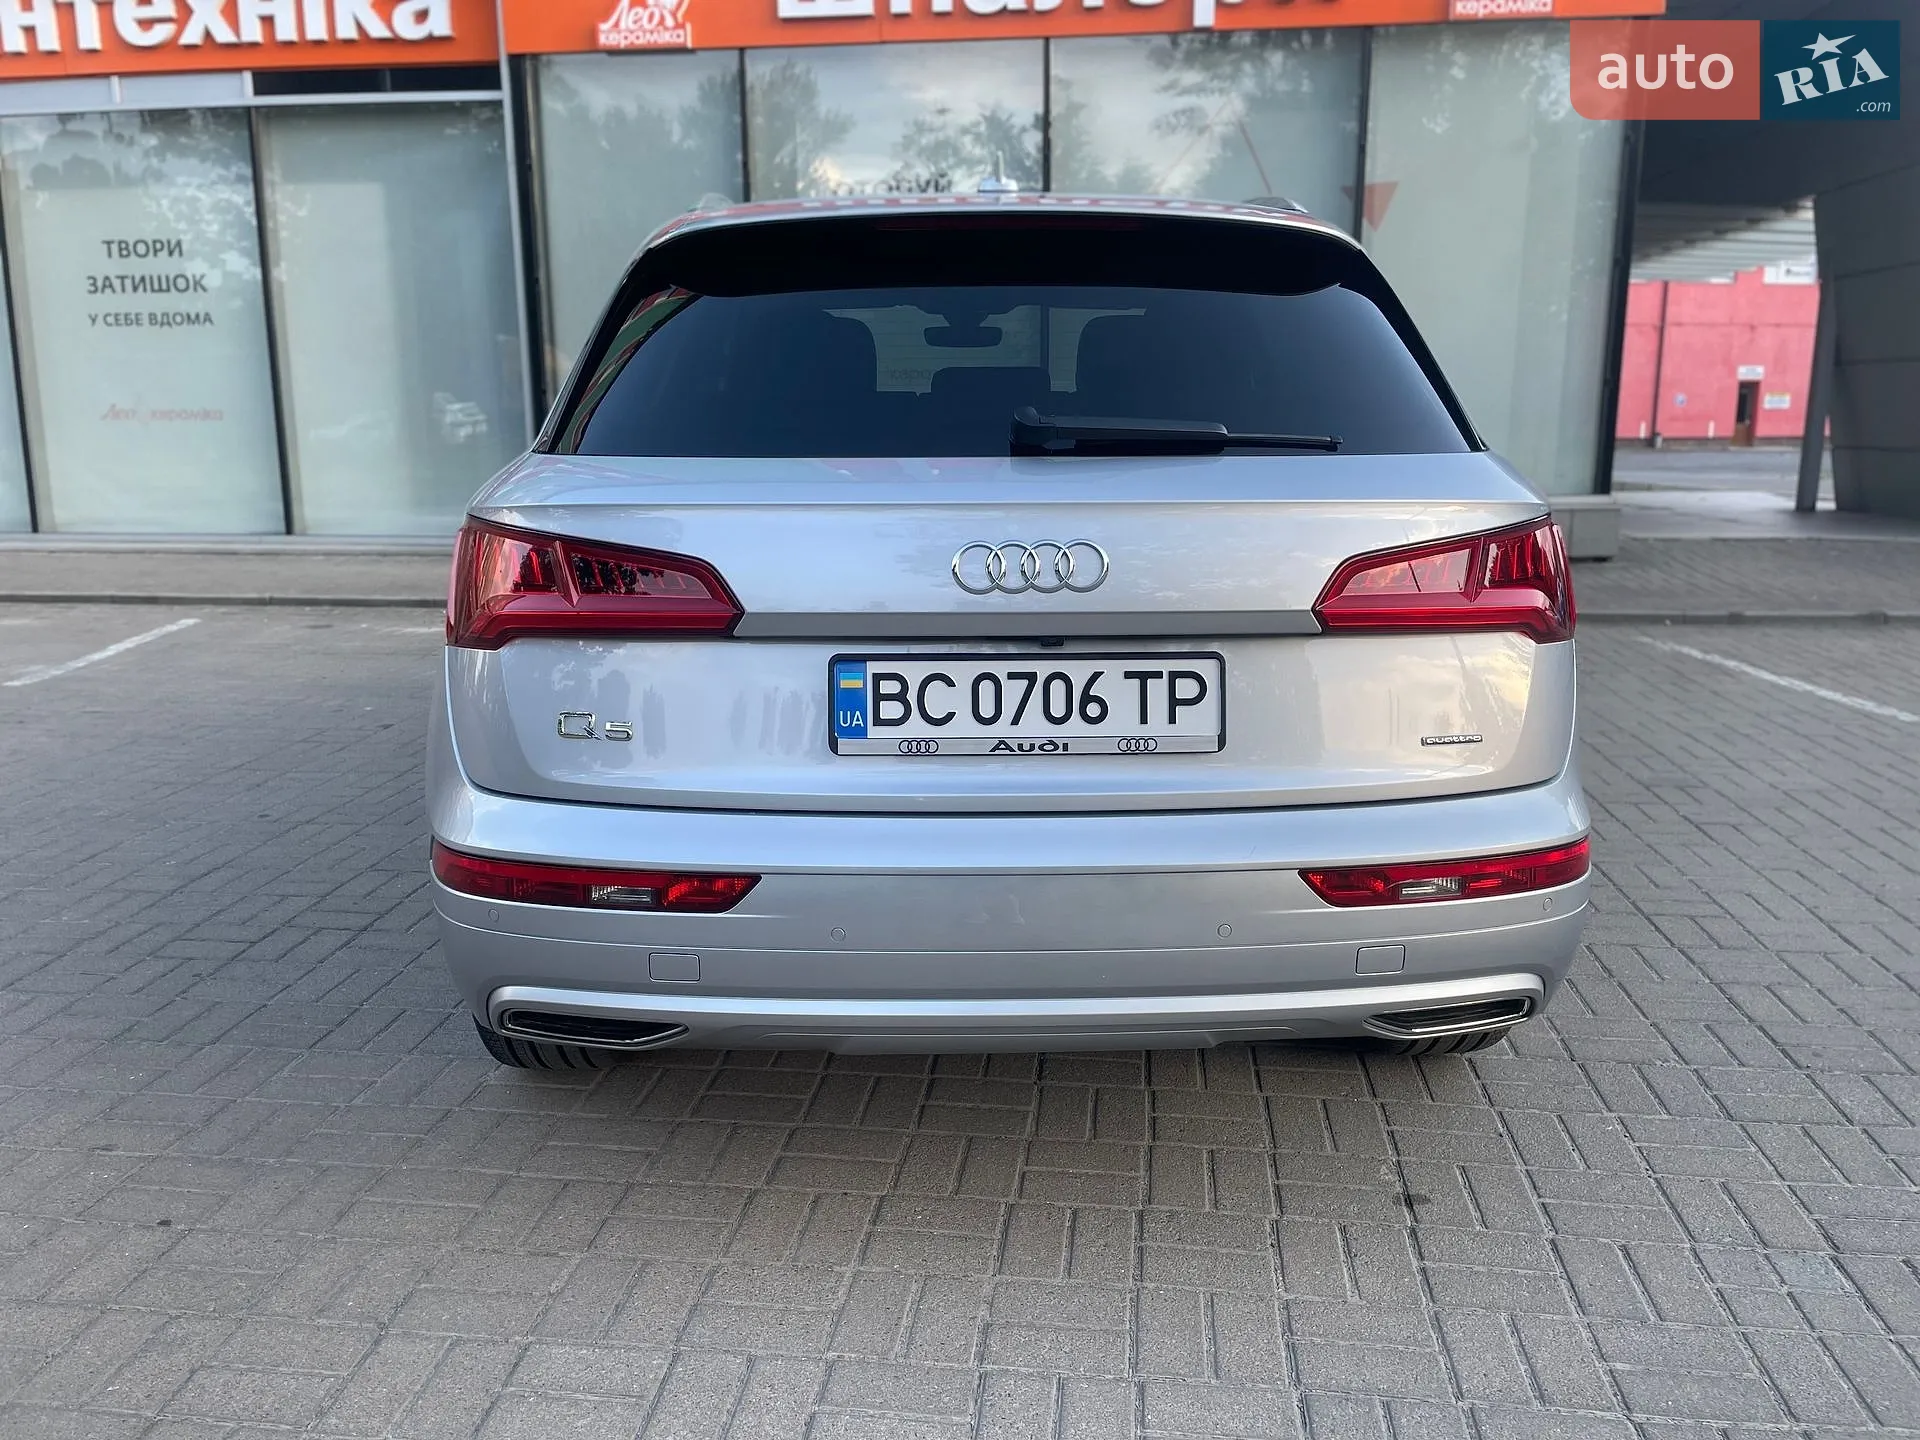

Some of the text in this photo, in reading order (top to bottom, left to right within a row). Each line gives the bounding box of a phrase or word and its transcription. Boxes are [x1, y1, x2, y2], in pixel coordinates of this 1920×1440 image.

[599, 27, 685, 49] кераміка
[101, 239, 184, 259] ТВОРИ
[86, 273, 208, 295] ЗАТИШОК
[88, 311, 215, 329] У СЕБЕ ВДОМА
[872, 669, 1208, 727] BC 0706 TP
[558, 711, 633, 741] Q5
[839, 710, 865, 728] UA
[988, 739, 1069, 753] Audi
[1425, 735, 1482, 745] quattro
